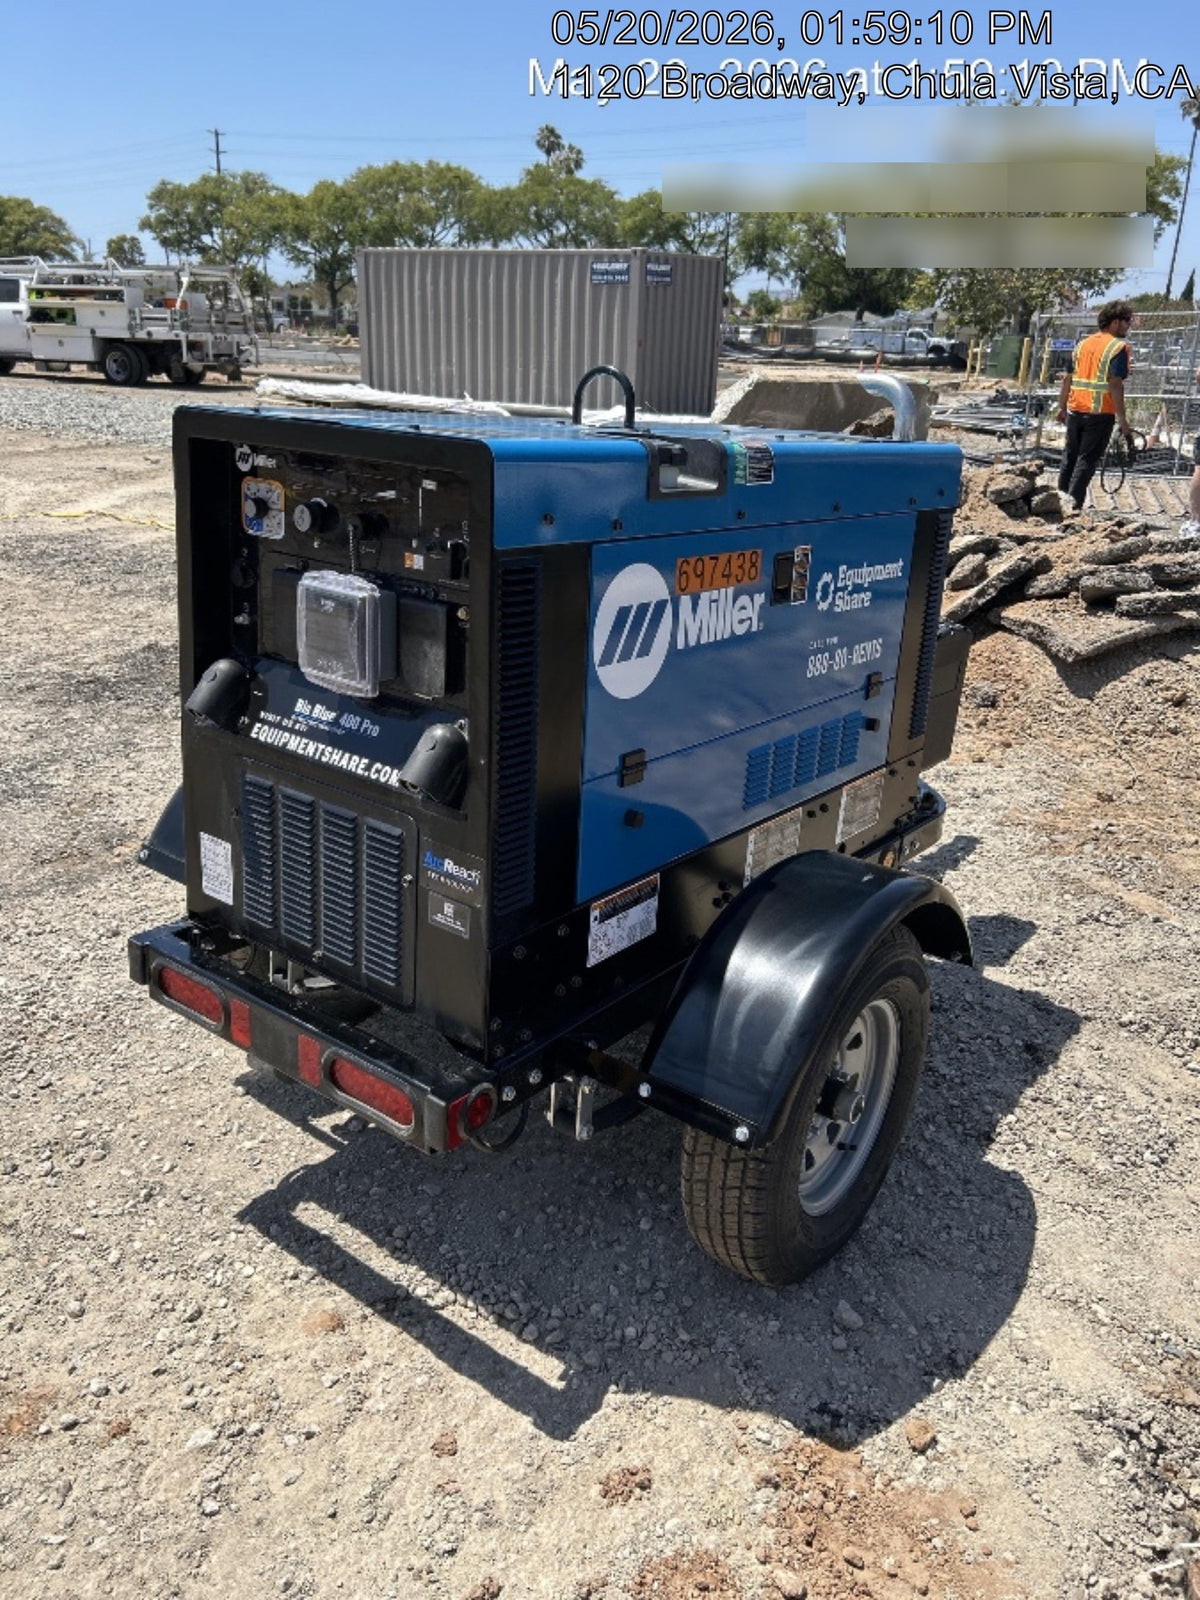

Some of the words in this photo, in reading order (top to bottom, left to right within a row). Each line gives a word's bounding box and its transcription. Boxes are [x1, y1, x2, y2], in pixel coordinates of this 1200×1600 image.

[678, 551, 760, 593] 697438
[837, 558, 904, 590] Equipment
[834, 591, 872, 612] Share
[677, 587, 766, 650] Miller
[360, 718, 380, 737] Pro
